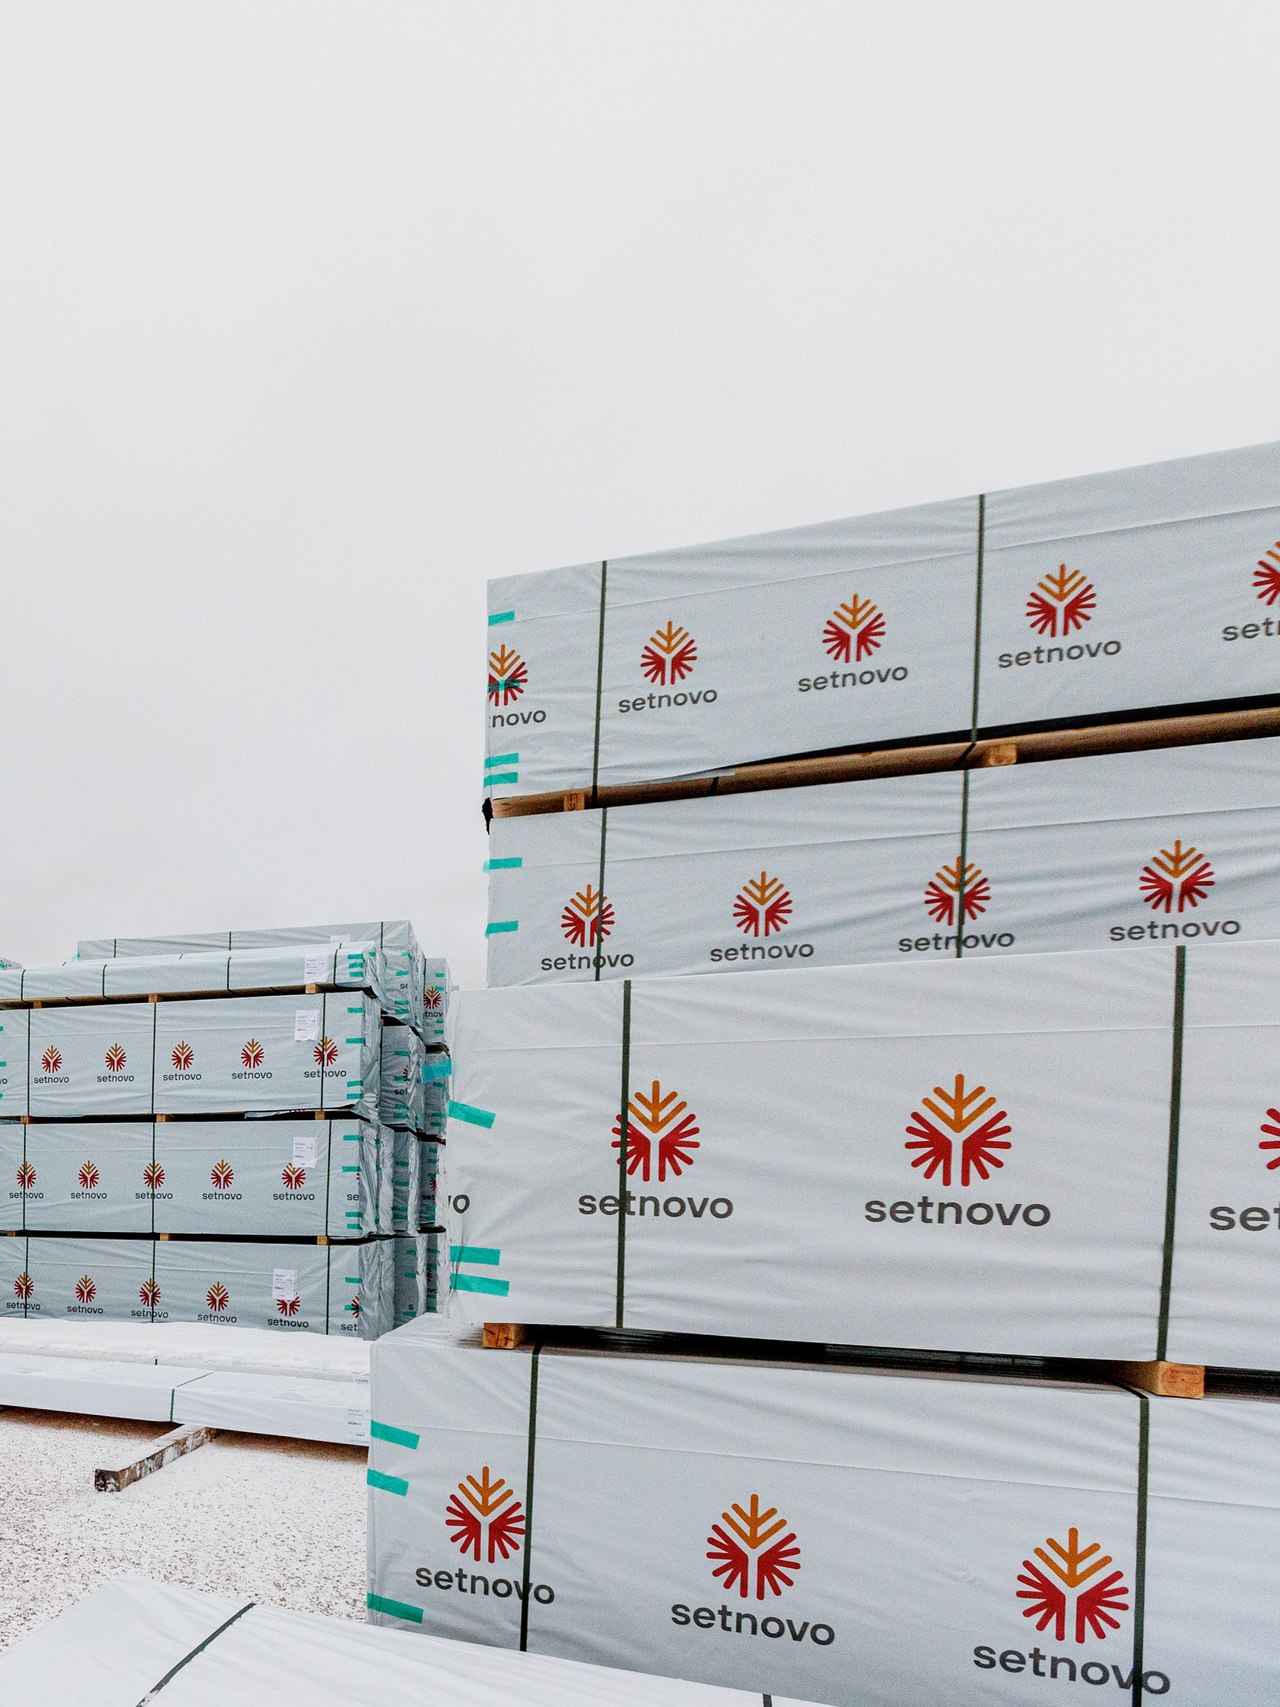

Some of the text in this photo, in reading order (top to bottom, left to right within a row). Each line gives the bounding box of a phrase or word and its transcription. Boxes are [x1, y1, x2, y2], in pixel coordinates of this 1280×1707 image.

[998, 639, 1122, 668] setnovo
[798, 665, 909, 692] setnovo
[618, 688, 718, 713] setnovo
[488, 710, 547, 728] novo
[1109, 919, 1242, 942] setnovo
[898, 931, 1015, 953] setnovo
[710, 942, 815, 962] setnovo
[540, 952, 635, 971] setnovo
[96, 1073, 135, 1082] setnovo
[163, 1071, 202, 1081] setnovo
[231, 1069, 273, 1079] setnovo
[304, 1067, 347, 1078] setnovo
[33, 1075, 70, 1084] setnovo
[9, 1190, 44, 1200] setnovo
[70, 1191, 108, 1200] setnovo
[202, 1190, 243, 1201] setnovo
[272, 1190, 315, 1201] setnovo
[577, 1190, 734, 1219] setnovo
[864, 1195, 1052, 1227] setnovo
[6, 1300, 41, 1311] setnovo
[67, 1303, 104, 1314] setnovo
[131, 1307, 170, 1319] setnovo
[197, 1311, 238, 1324] setnovo
[267, 1316, 309, 1328] setnovo
[415, 1567, 556, 1605] setnovo
[670, 1603, 836, 1646] setnovo
[972, 1644, 1172, 1695] setnovo
